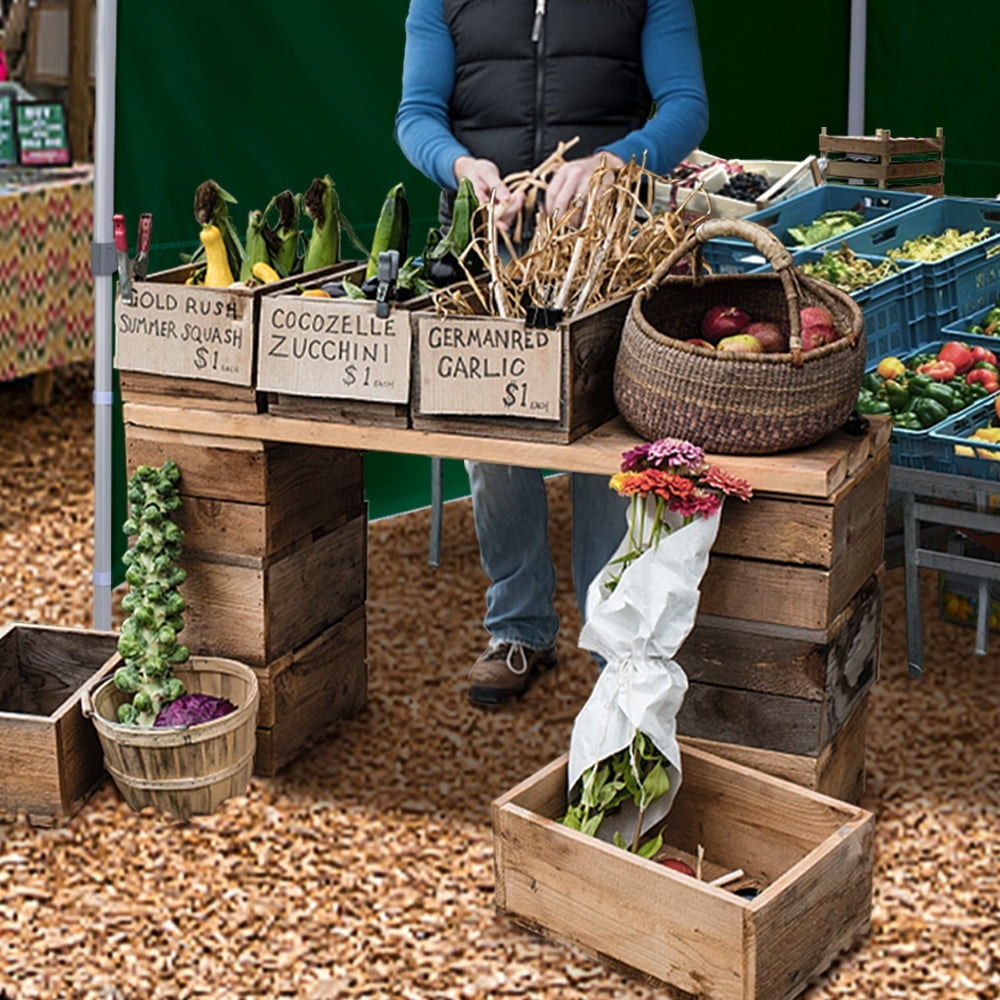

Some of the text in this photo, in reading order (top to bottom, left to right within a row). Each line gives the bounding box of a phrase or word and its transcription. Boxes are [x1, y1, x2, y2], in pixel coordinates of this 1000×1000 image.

[185, 297, 238, 320] RUSH
[119, 313, 243, 349] SUMMER SQUASH
[271, 308, 396, 337] COCOZELLE
[193, 346, 218, 370] $1
[267, 334, 389, 364] ZUCCHINI
[342, 364, 371, 386] $1
[437, 355, 526, 379] GARLIC
[502, 381, 527, 408] $1
